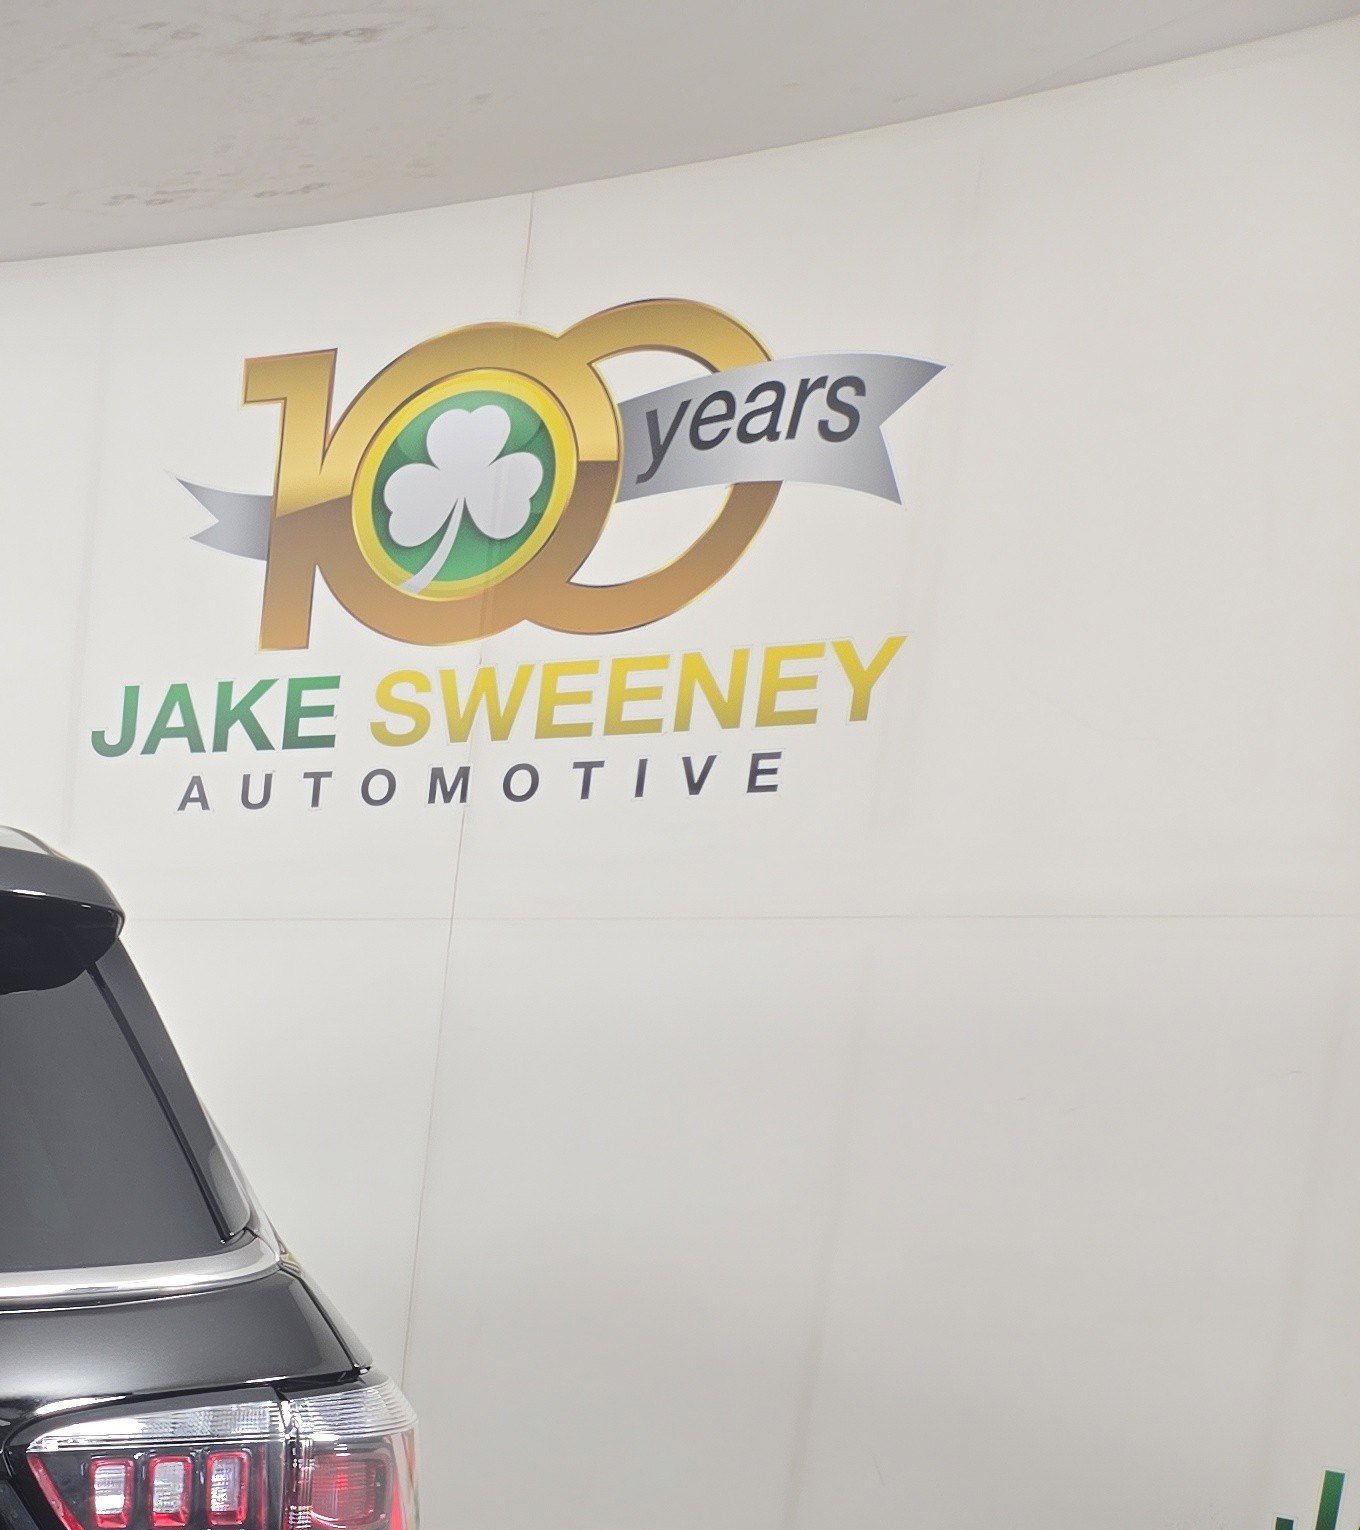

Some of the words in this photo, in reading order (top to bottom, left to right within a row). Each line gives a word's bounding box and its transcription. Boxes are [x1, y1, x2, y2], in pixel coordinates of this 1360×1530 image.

[635, 371, 868, 484] years
[90, 674, 341, 758] JAKE
[370, 634, 908, 748] SWEENEY
[177, 749, 784, 812] AUTOMOTIVE
